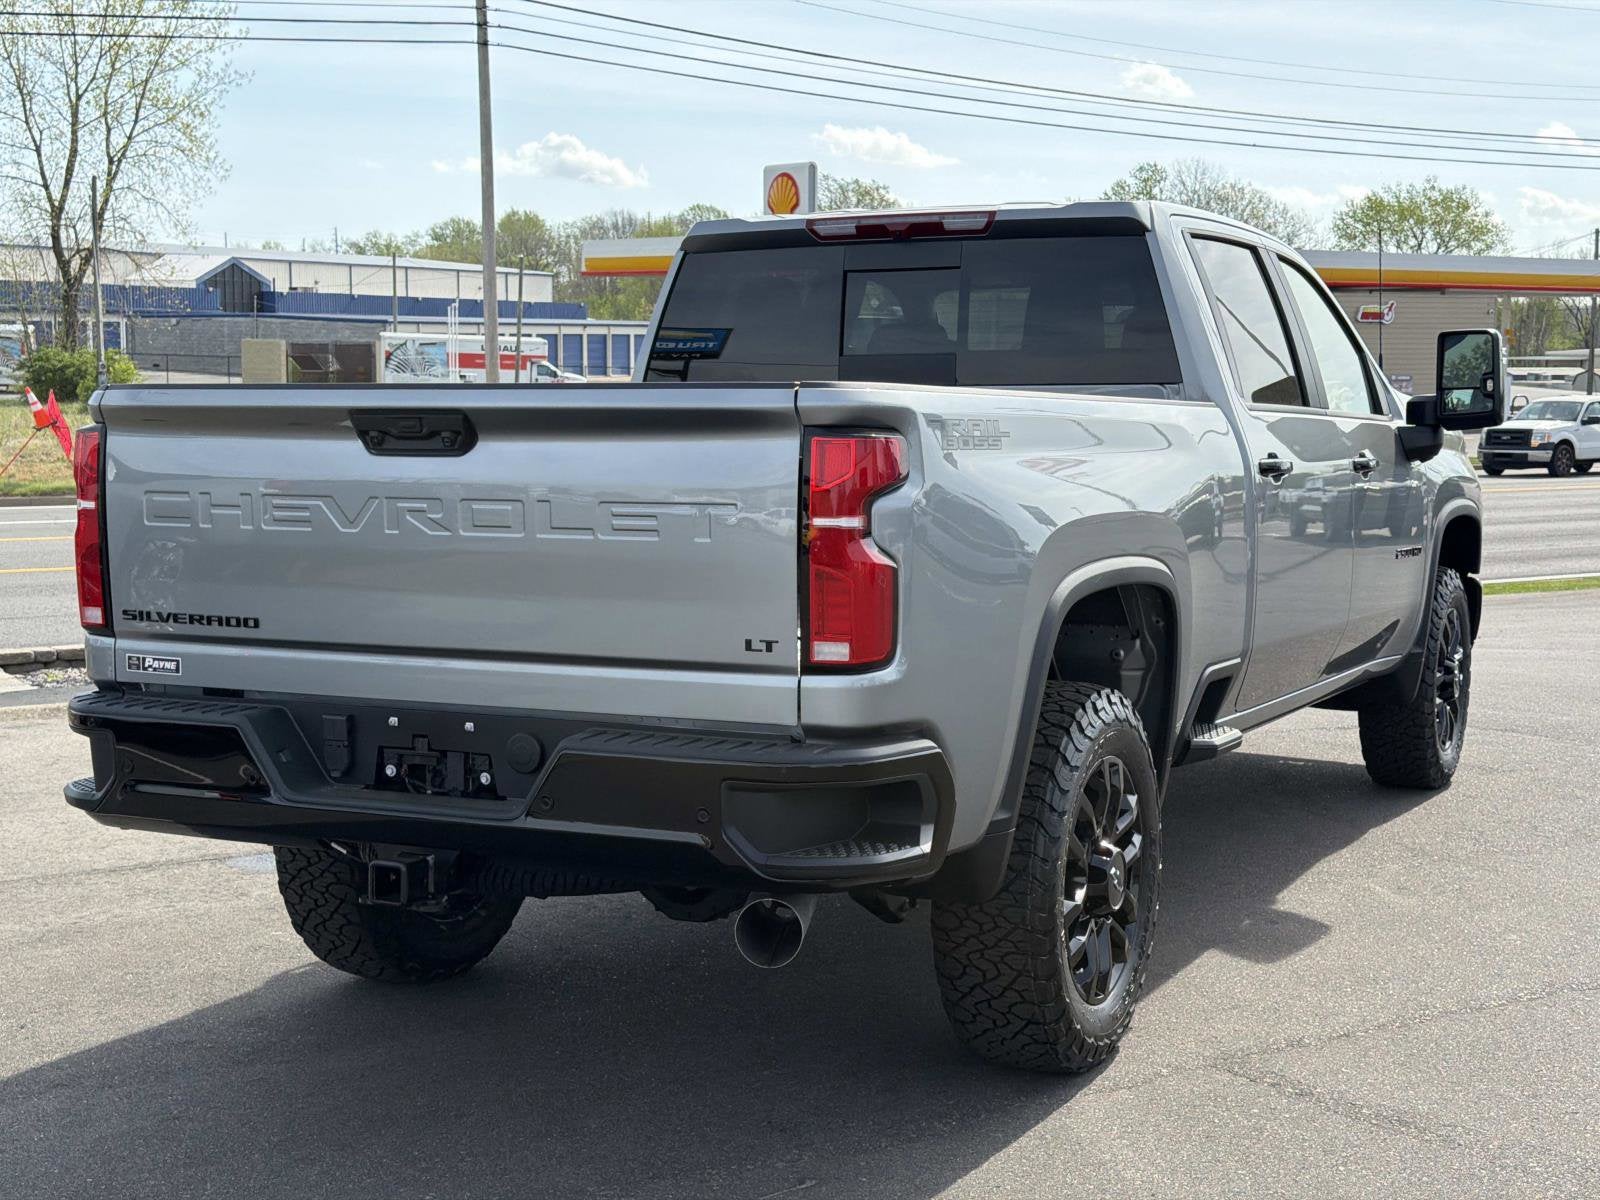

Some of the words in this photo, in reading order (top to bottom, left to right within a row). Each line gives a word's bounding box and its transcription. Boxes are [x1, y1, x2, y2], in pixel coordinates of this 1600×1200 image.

[942, 436, 1003, 450] BOSS
[144, 490, 739, 542] CHEVROLET
[122, 609, 260, 629] SILVERADO
[744, 638, 779, 653] LT
